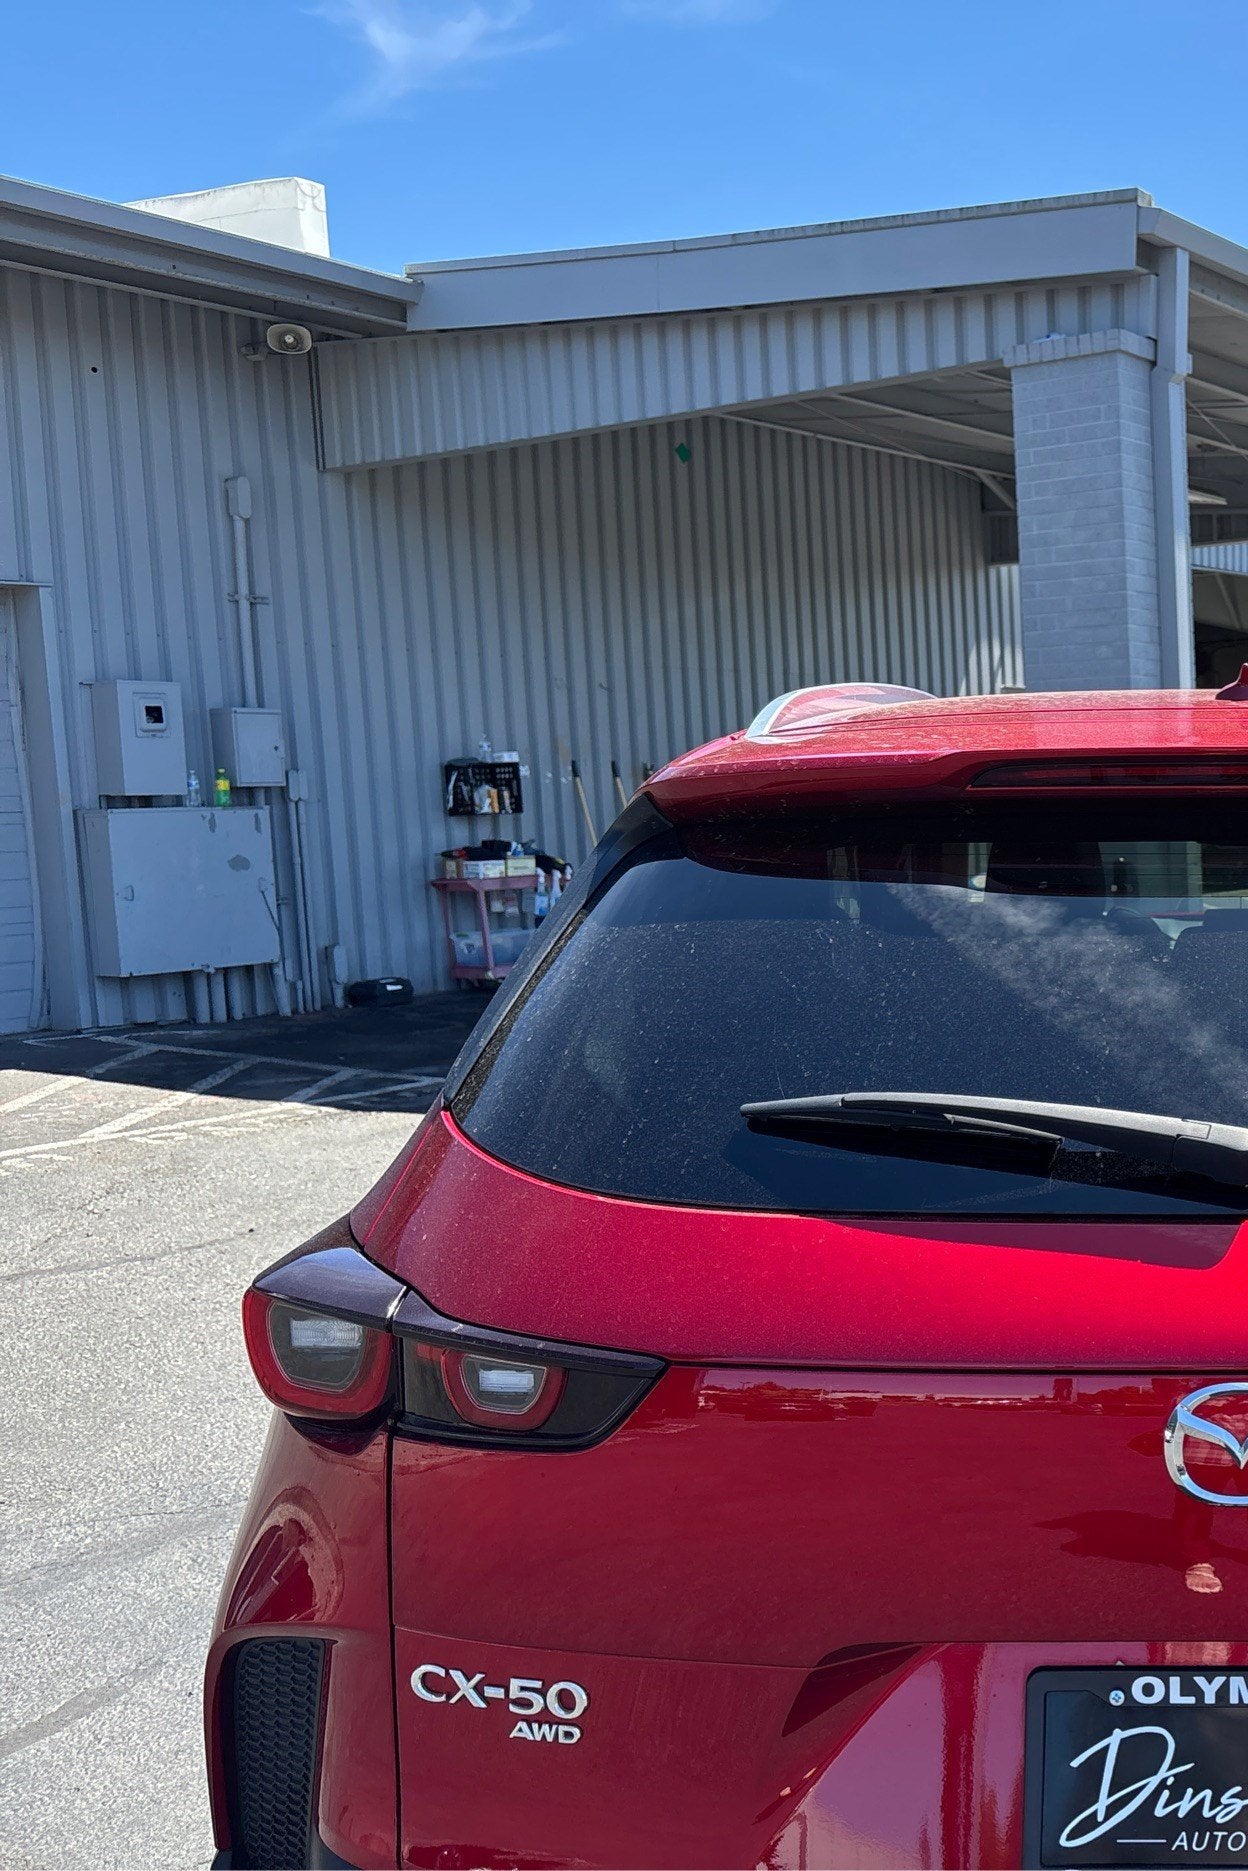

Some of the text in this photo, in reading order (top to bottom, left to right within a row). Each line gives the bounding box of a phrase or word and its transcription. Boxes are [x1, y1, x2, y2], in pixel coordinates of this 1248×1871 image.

[410, 1664, 588, 1719] CX-50
[509, 1721, 582, 1744] AWD
[1172, 1831, 1246, 1851] AUTO
